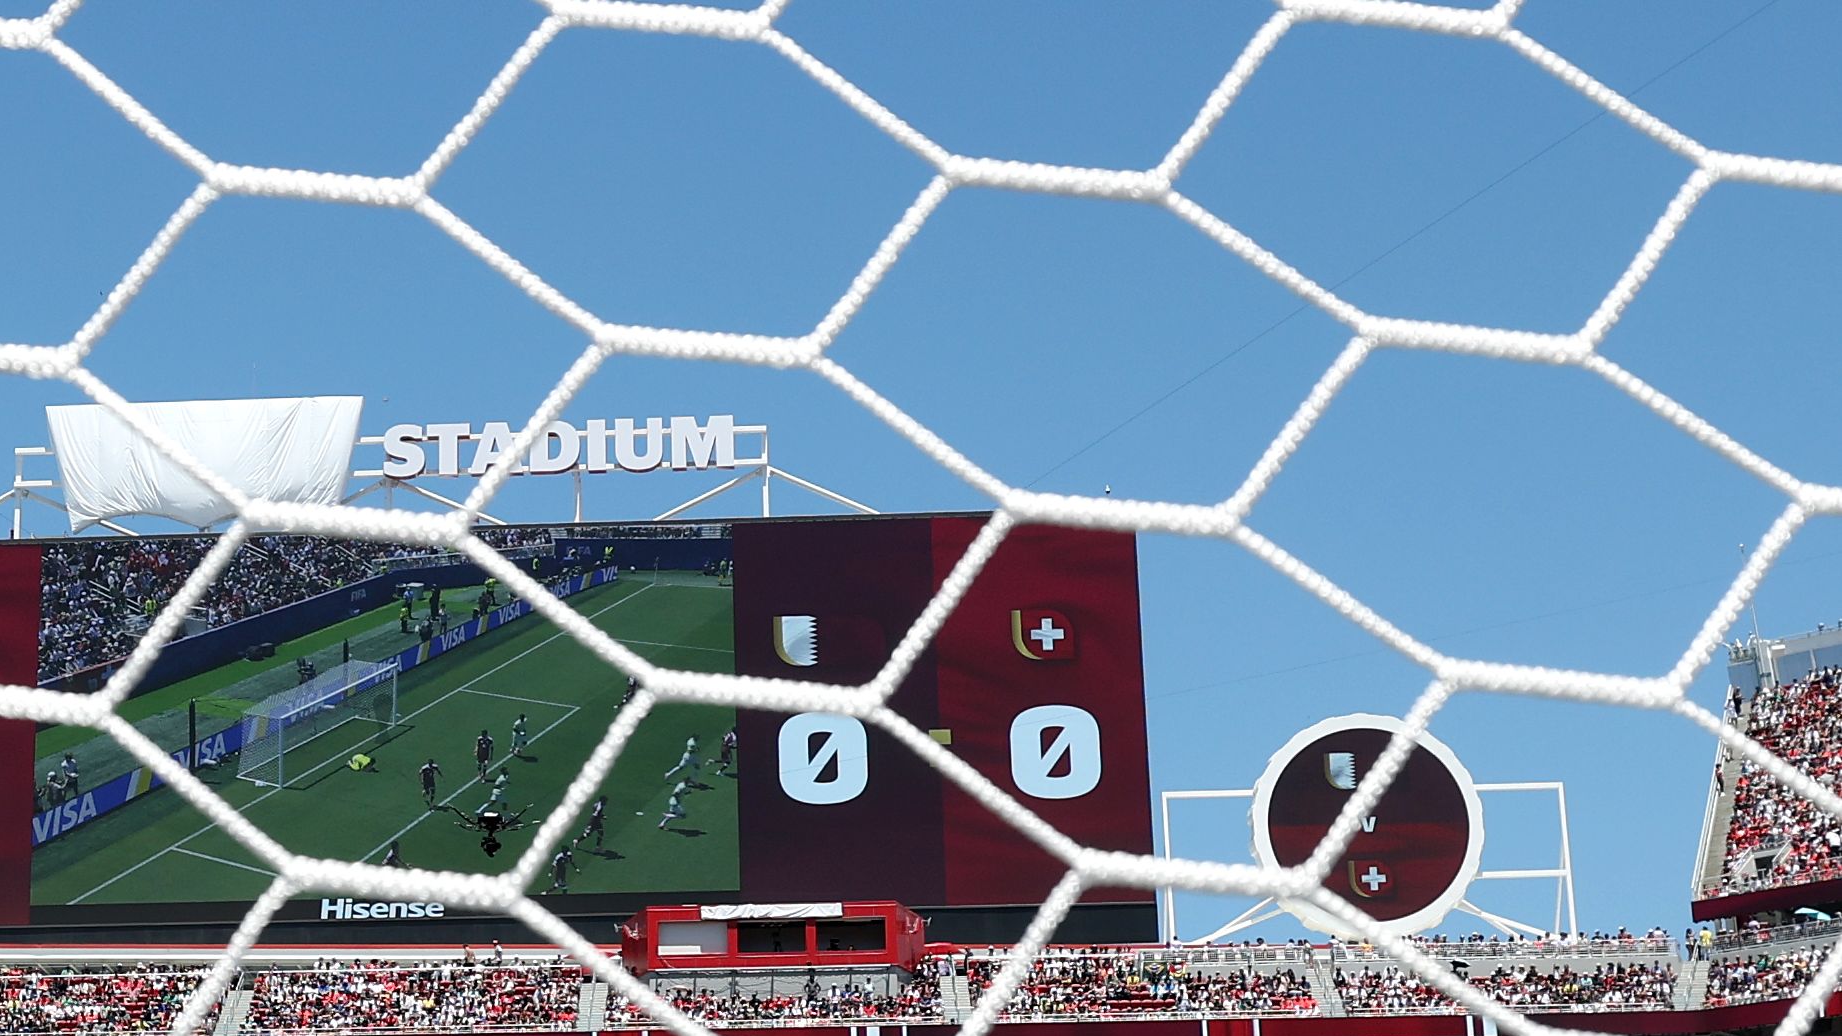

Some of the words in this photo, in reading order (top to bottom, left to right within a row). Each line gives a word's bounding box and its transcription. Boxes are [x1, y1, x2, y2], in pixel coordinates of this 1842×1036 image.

[383, 414, 735, 479] STADIUM
[499, 602, 522, 624] VISA
[440, 626, 466, 651] VISA
[32, 791, 98, 846] VISA
[320, 898, 445, 919] Hisense
